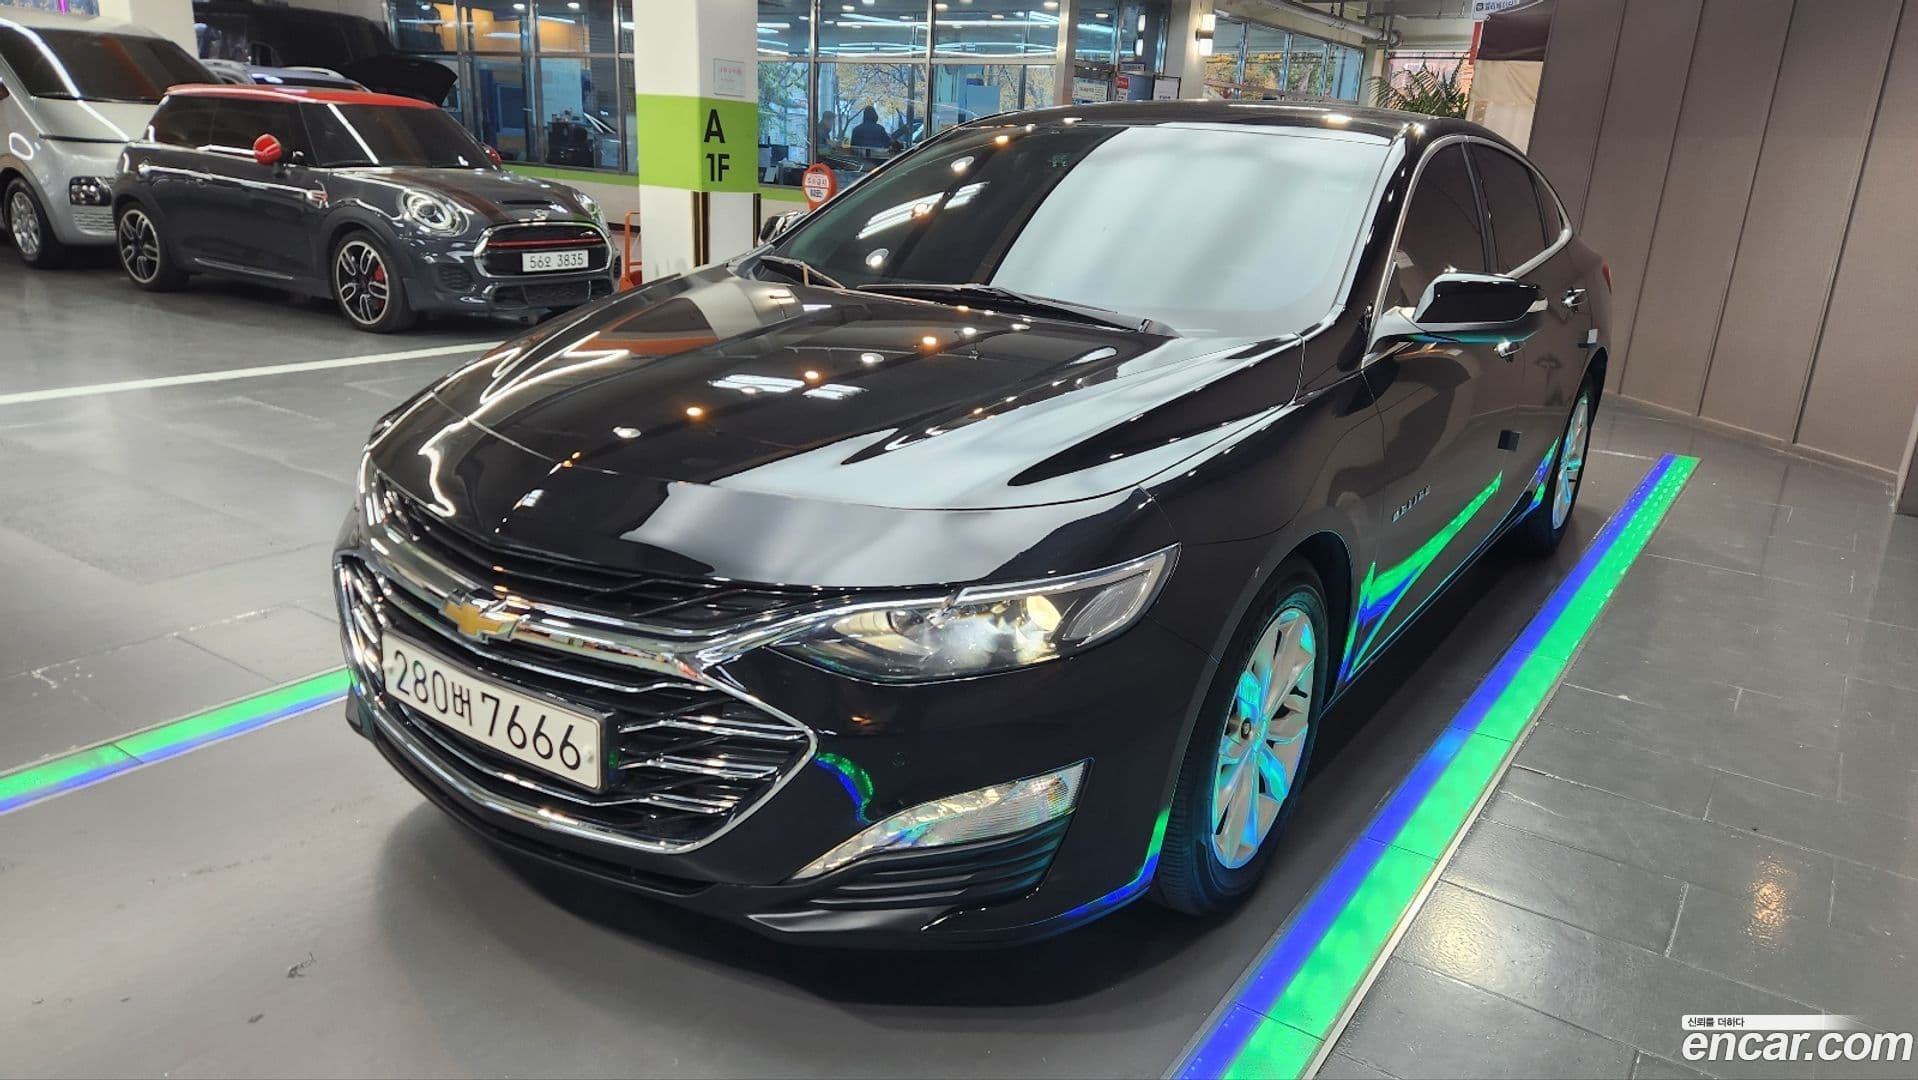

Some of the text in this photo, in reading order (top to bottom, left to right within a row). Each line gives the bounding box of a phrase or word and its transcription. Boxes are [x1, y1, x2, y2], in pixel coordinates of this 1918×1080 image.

[703, 108, 726, 144] A
[705, 153, 730, 182] 1F
[529, 253, 584, 269] 56오 3835
[394, 650, 581, 771] 280버 7666
